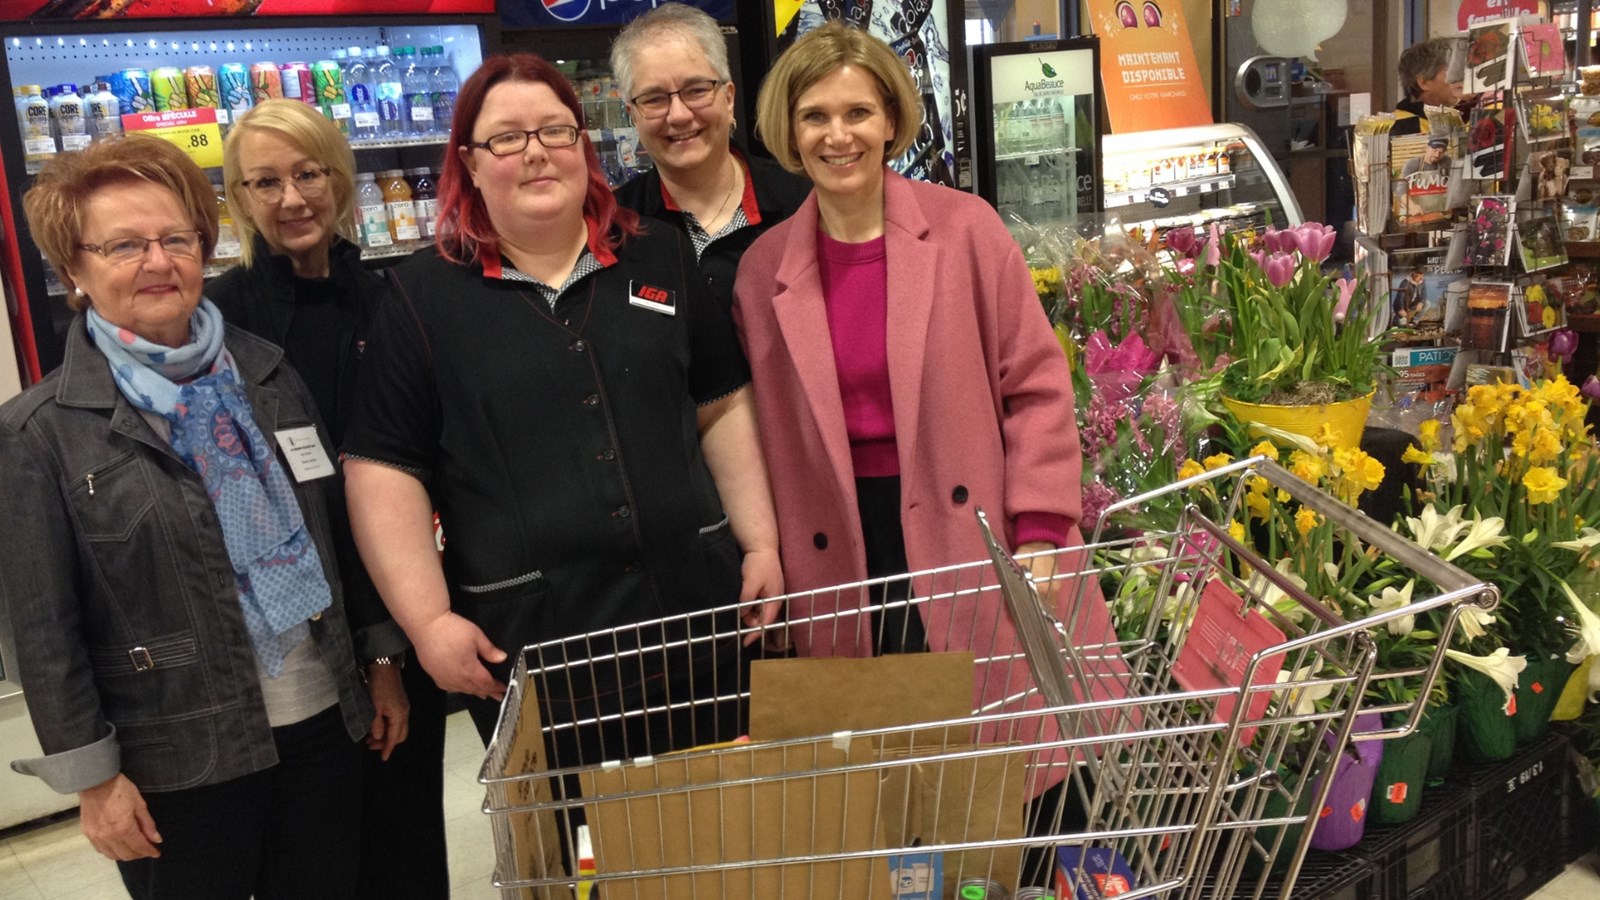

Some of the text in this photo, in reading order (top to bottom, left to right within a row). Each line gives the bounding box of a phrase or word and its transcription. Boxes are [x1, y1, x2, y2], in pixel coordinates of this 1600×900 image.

[1117, 51, 1181, 67] MAINTENANT
[1121, 67, 1186, 84] DISPONIBLE
[1024, 79, 1064, 92] AquaBeauce
[28, 106, 47, 116] CORE
[60, 103, 79, 114] CORE
[187, 134, 208, 147] .88
[638, 285, 668, 303] IGA
